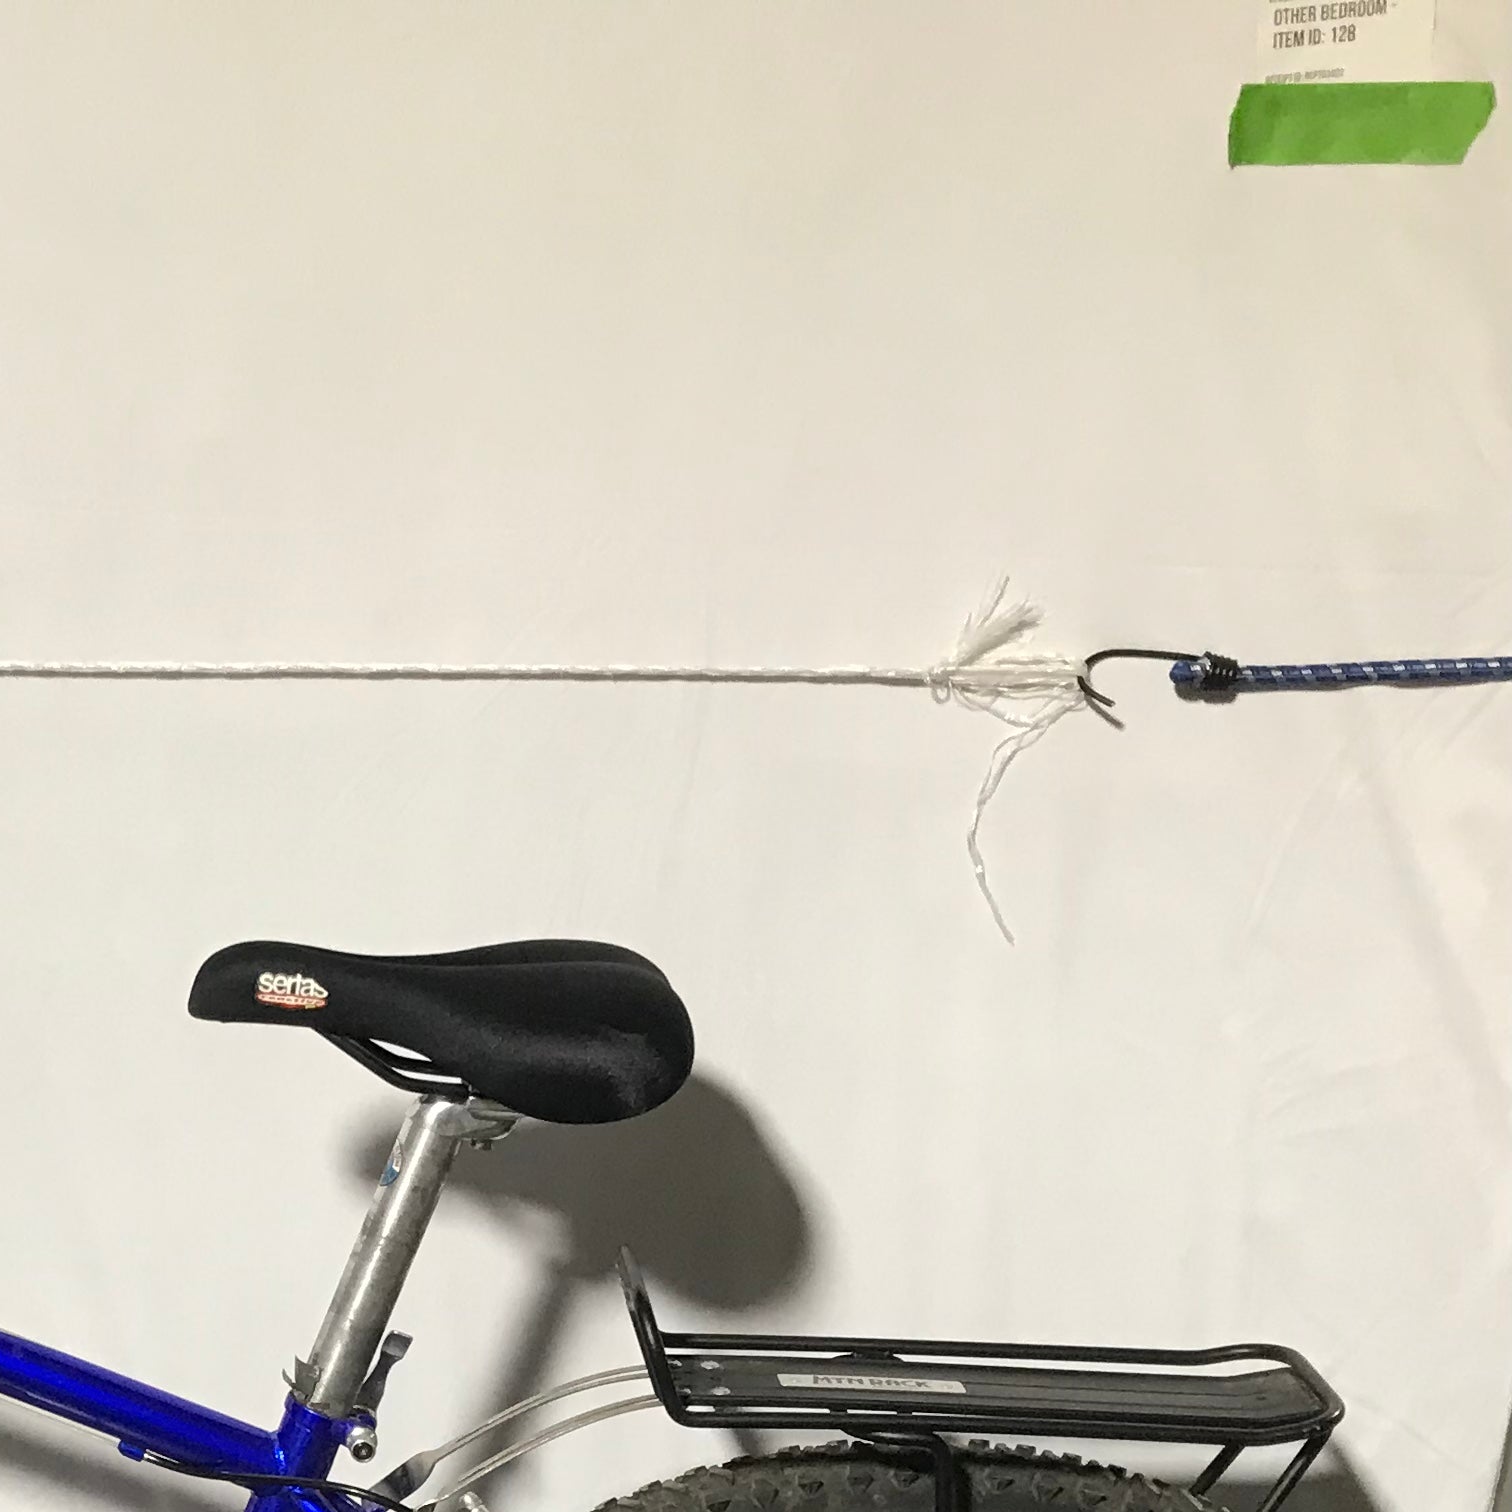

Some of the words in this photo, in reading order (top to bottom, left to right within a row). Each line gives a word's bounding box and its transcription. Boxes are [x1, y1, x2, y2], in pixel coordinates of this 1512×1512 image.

[1273, 5, 1317, 26] OTHER
[1320, 0, 1388, 21] BEDROOM
[1272, 29, 1305, 49] ITEM
[1308, 27, 1326, 46] ID:
[1331, 23, 1356, 43] 128
